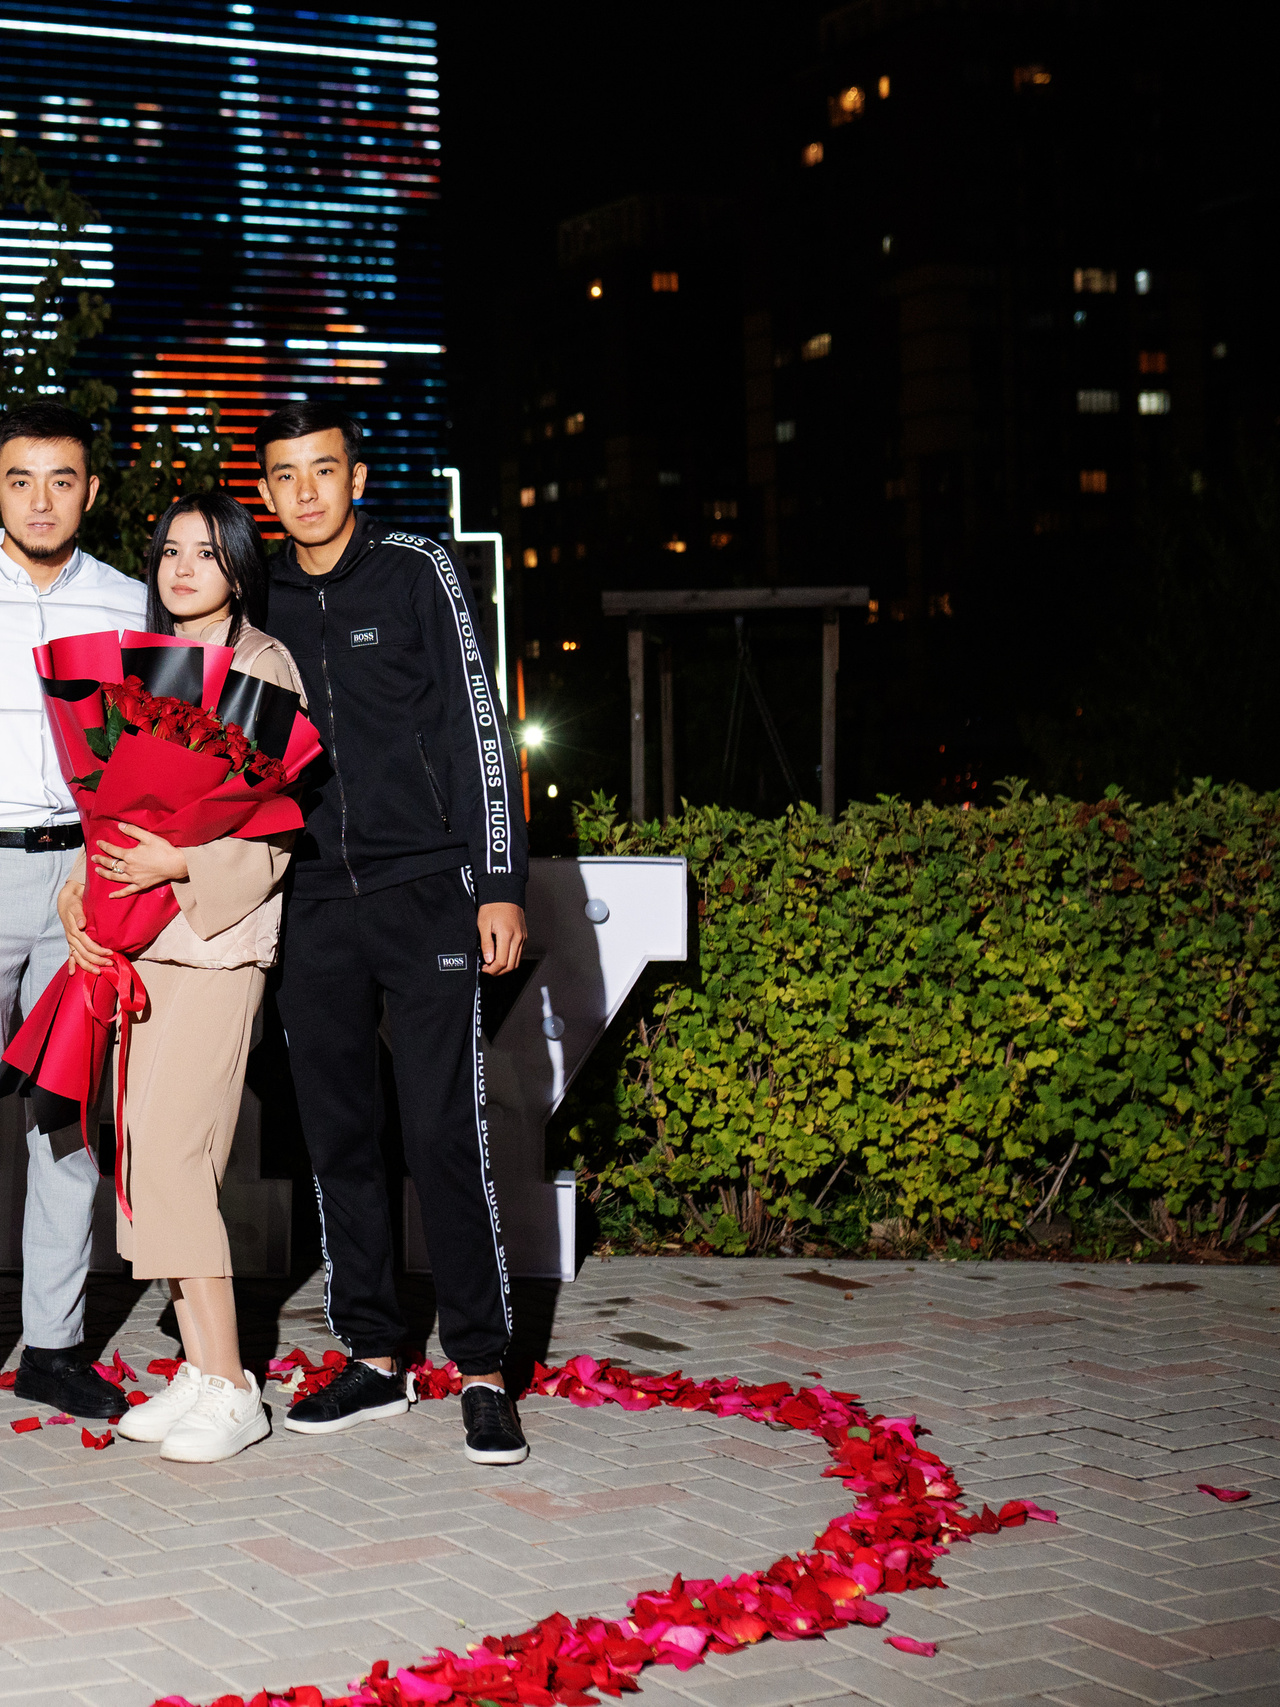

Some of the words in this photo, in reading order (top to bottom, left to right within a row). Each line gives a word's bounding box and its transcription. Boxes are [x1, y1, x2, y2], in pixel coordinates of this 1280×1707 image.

[432, 549, 461, 598] HUGO
[353, 632, 374, 642] BOSS
[459, 612, 478, 661] BOSS
[471, 674, 492, 727] HUGO
[483, 739, 502, 788] BOSS
[490, 800, 506, 853] HUGO
[442, 957, 464, 966] BOSS
